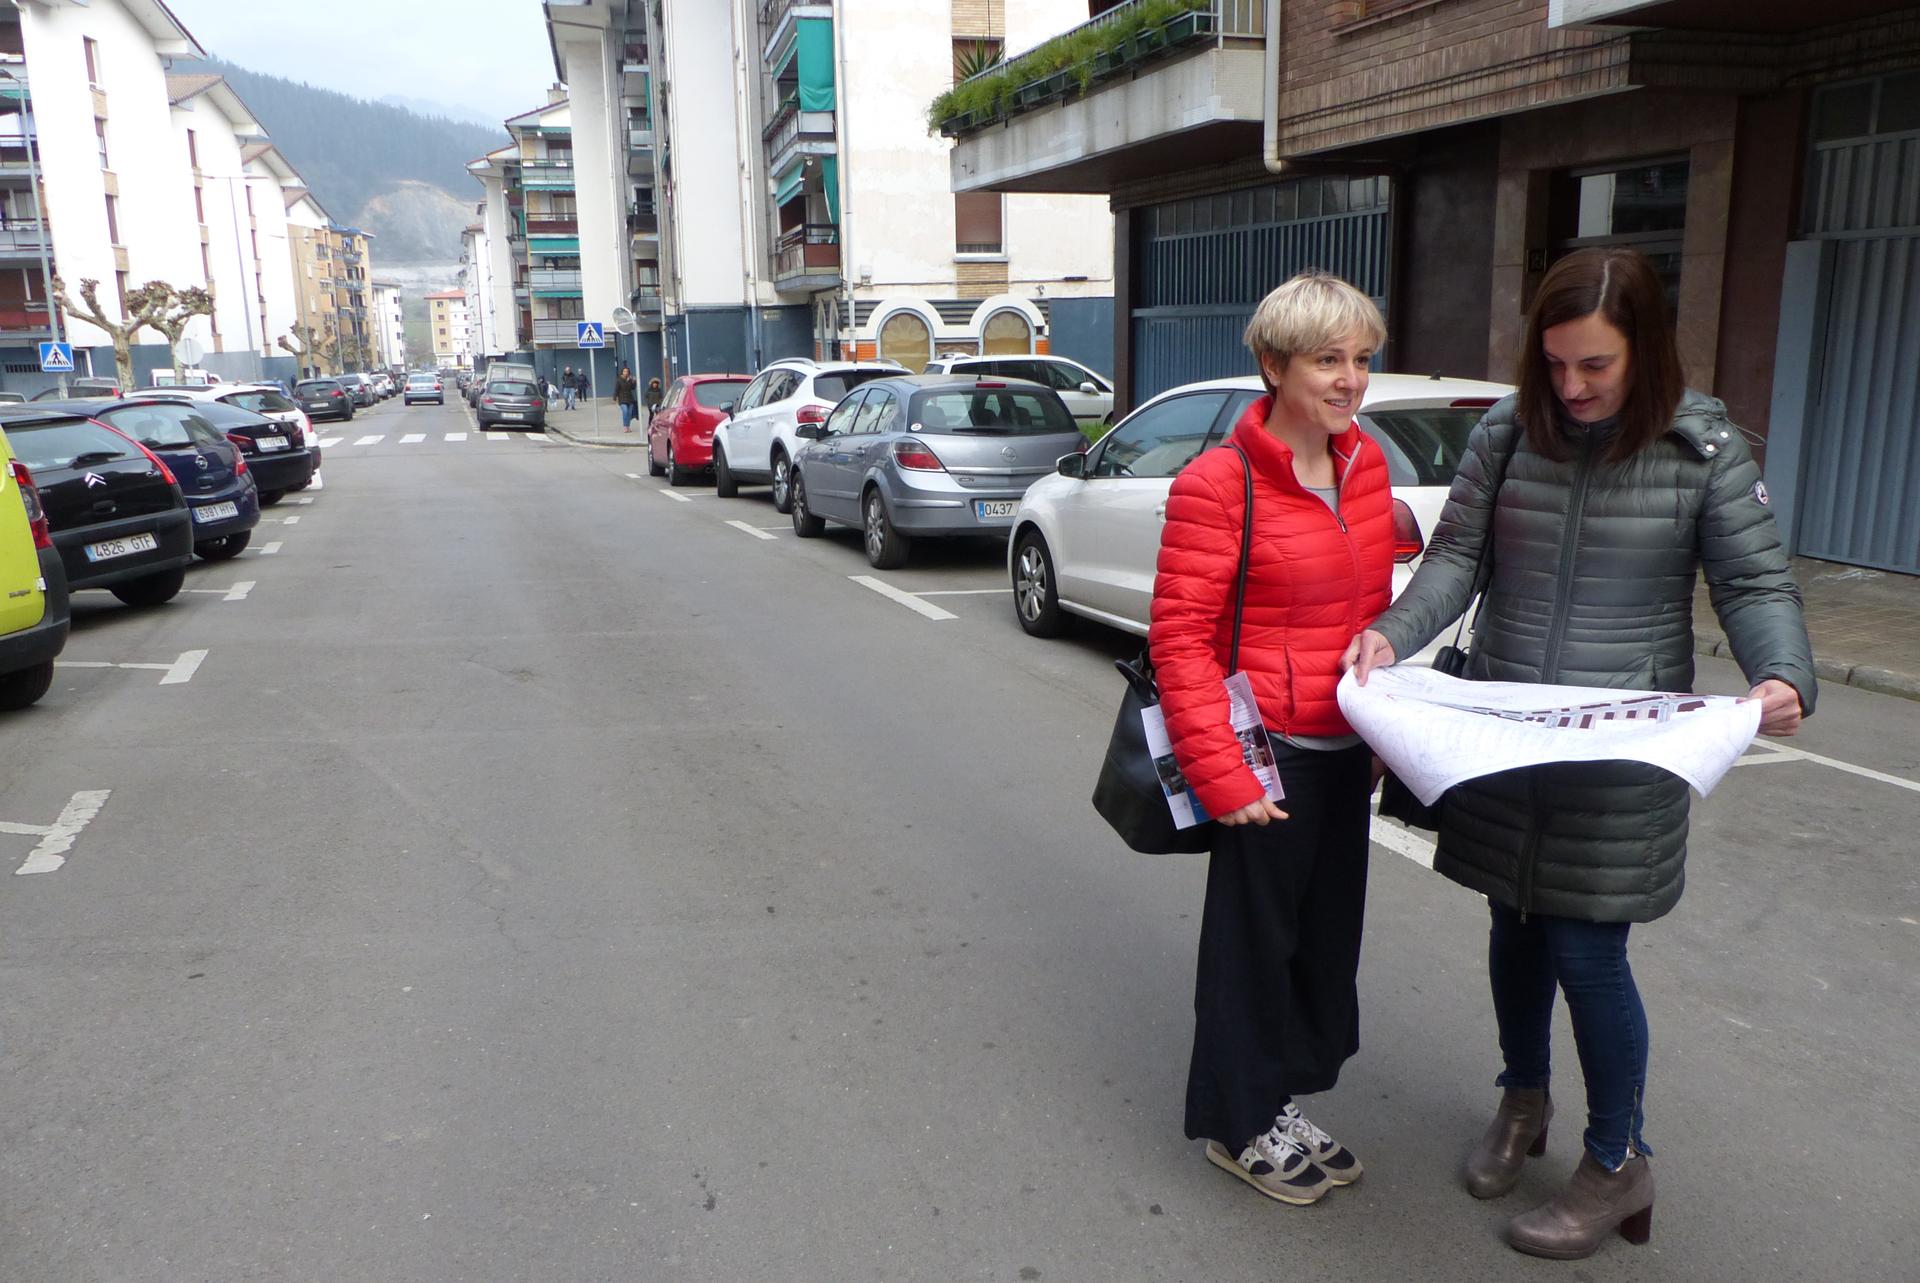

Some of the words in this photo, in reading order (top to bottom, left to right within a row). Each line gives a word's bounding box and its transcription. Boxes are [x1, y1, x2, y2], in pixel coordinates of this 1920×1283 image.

[985, 503, 1013, 516] 0437
[95, 541, 126, 558] 4826
[130, 534, 152, 551] GTF
